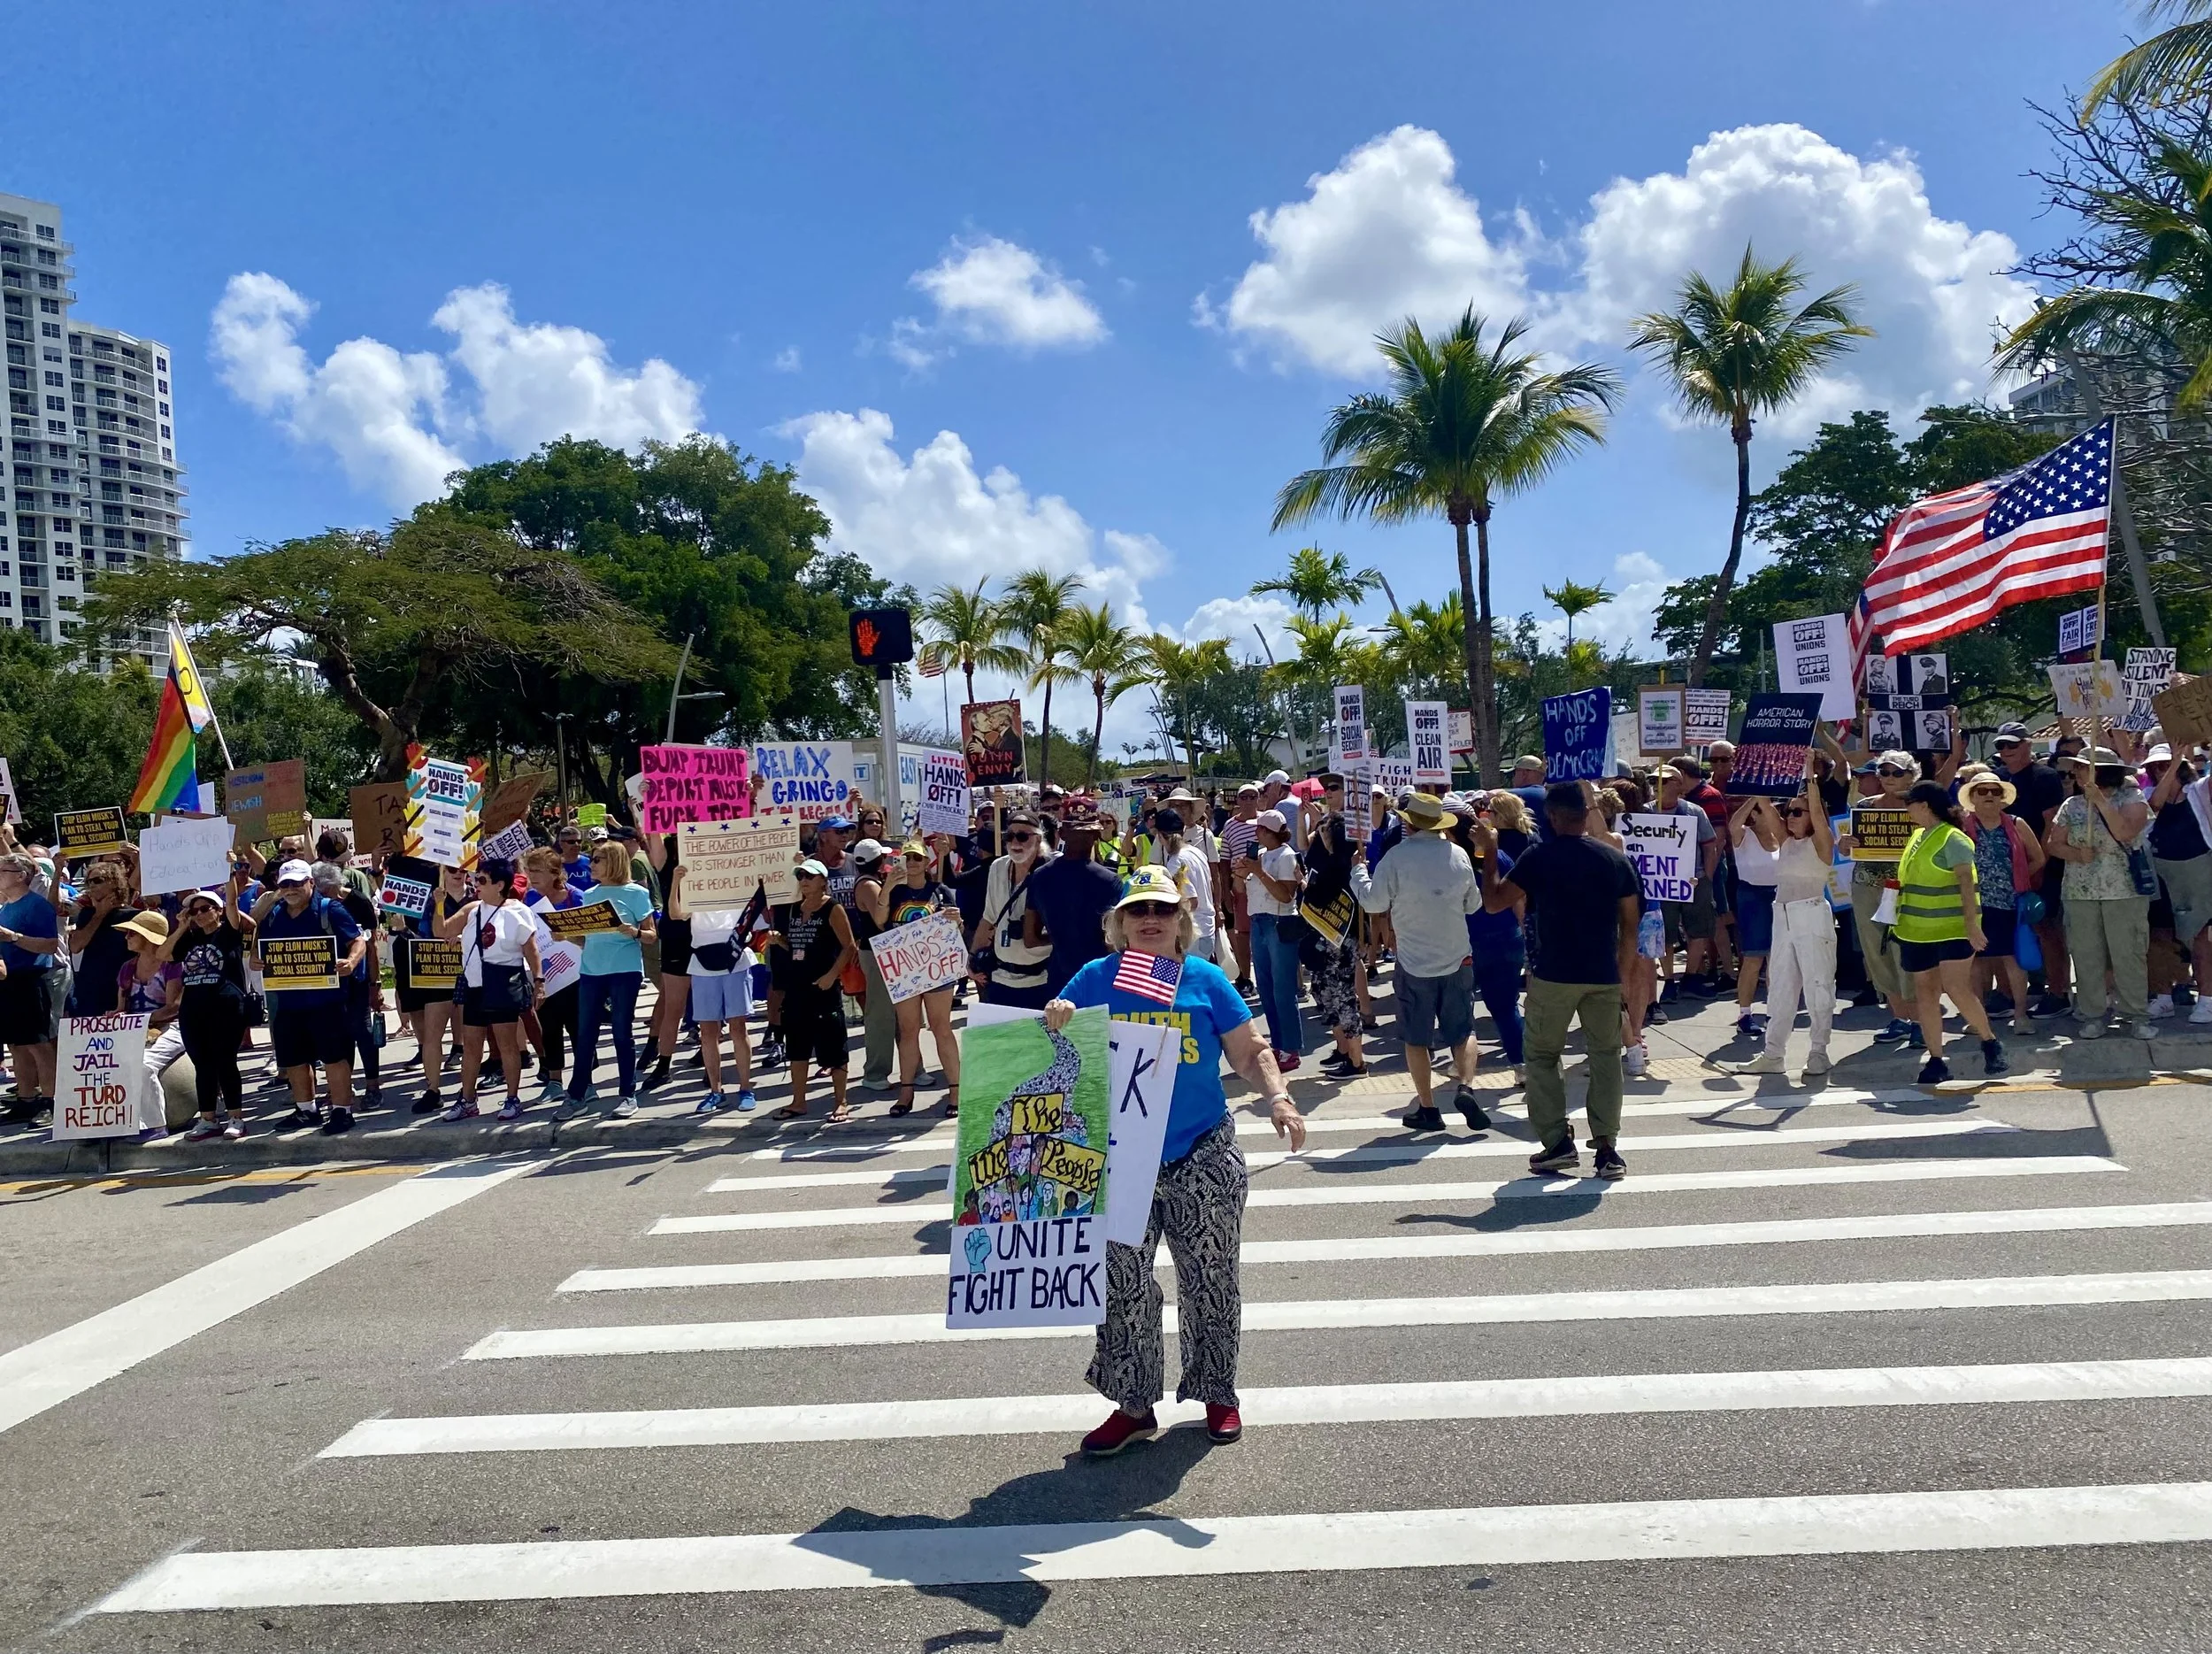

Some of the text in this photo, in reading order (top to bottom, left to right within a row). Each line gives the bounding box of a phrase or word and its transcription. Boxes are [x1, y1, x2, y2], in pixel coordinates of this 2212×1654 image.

[1793, 622, 1823, 631] HANDS
[2085, 621, 2098, 634] FRE
[1795, 629, 1824, 642] OFF!
[2062, 628, 2079, 642] FAIR
[1796, 640, 1825, 651] UNIONS
[1798, 656, 1827, 665] HANDS
[2128, 649, 2176, 664] STAYING
[1799, 663, 1829, 674] OFF!
[2125, 663, 2170, 681] SILENT
[1800, 673, 1830, 685] UNIONS
[1340, 695, 1360, 705] HANDS
[1341, 705, 1361, 721] OFF!
[1545, 694, 1597, 724] HANDS
[1757, 708, 1804, 718] AMERICAN
[1416, 717, 1439, 729] OFF!
[1688, 713, 1724, 726] OFF!
[1747, 719, 1814, 728] HORROR STORY
[1340, 725, 1363, 741] SOCIAL
[1415, 733, 1440, 746] CLEAN
[1564, 726, 1587, 747] OFF
[1341, 739, 1363, 751] SECURITY
[643, 750, 745, 777] DUMP TRUMP
[757, 745, 832, 780] RELAX
[1417, 747, 1443, 769] AIR
[428, 767, 465, 783] HANDS
[900, 756, 917, 785] EASY
[924, 764, 966, 789] HANDS
[978, 763, 1011, 775] ENVY
[1380, 764, 1411, 775] FIGH
[428, 778, 465, 798] OFF!
[1374, 775, 1412, 786] TRUM
[648, 777, 749, 804] DEPORT MUSK
[772, 780, 848, 804] GRINGO
[927, 784, 962, 807] OFF!
[229, 795, 262, 812] JEWISH
[936, 804, 965, 815] DEMOCRACY
[62, 811, 114, 825] STOP ELON MUSK'S
[267, 810, 298, 819] AGAINST
[649, 804, 699, 832] FUCK
[1861, 812, 1897, 822] STOP ELON
[61, 820, 119, 835] PLAN TO STEAL YOUR
[321, 824, 354, 834] MORON
[1621, 813, 1686, 849] Security
[1858, 825, 1877, 835] PLAN
[1878, 825, 1886, 835] TO
[1888, 825, 1909, 835] STEAL
[67, 831, 116, 844] SOCIAL SECURITY
[503, 834, 518, 856] CIVIL
[685, 832, 797, 853] THE POWER OF THE PEOPLE
[1864, 836, 1910, 846] SOCIAL SECU
[692, 851, 786, 872] IS STRONGER THAN
[1628, 854, 1678, 877] MENT
[384, 880, 427, 897] HANDS
[687, 871, 786, 891] THE PEOPLE IN POWER
[1644, 878, 1692, 901] RNED
[575, 915, 595, 924] STEAL
[268, 940, 326, 952] STOP ELON MUSK'S
[419, 942, 449, 952] STOP ELON
[266, 951, 331, 964] PLAN TO STEAL YOUR
[416, 954, 431, 964] PLAN
[442, 954, 459, 964] STEAL
[877, 935, 941, 981] HANDS
[273, 964, 326, 975] SOCIAL SECURITY
[421, 965, 463, 974] SOCIAL SECUR
[928, 950, 964, 981] OFF!
[71, 1015, 145, 1036] PROSECUTE
[86, 1037, 114, 1051] AND
[73, 1053, 119, 1072] JAIL
[80, 1072, 111, 1086] THE
[73, 1085, 127, 1106] TURD
[65, 1104, 133, 1128] REICH!
[1014, 1096, 1061, 1131] The
[970, 1139, 1102, 1191] We People
[997, 1217, 1092, 1260] UNITE
[949, 1263, 1100, 1315] FIGHT BACK
